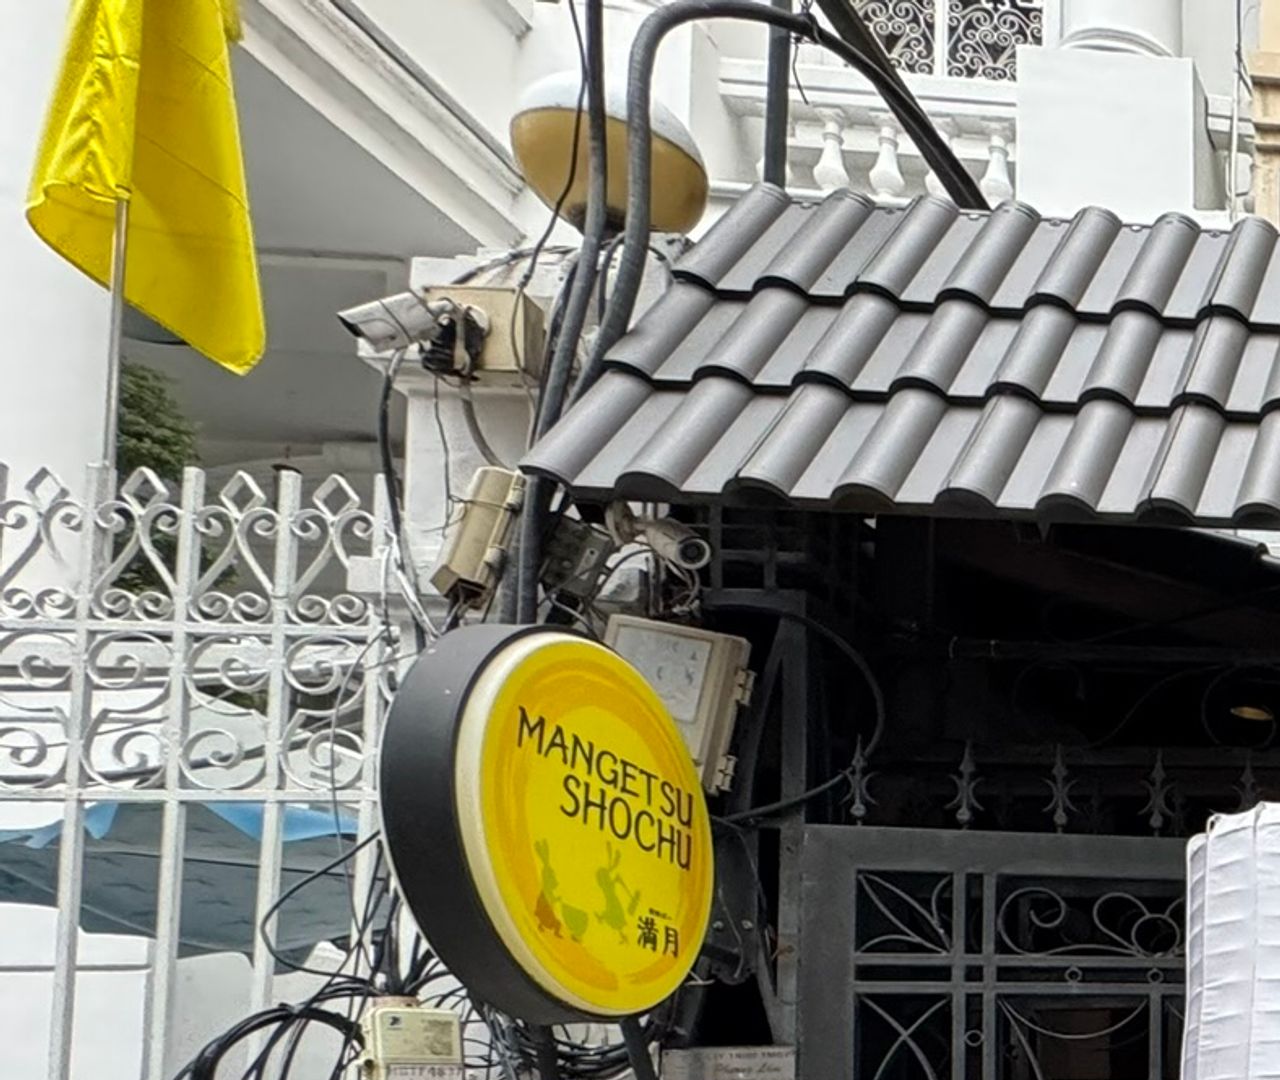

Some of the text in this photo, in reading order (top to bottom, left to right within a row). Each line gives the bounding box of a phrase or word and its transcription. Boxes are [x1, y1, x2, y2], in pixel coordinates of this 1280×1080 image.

[516, 705, 694, 830] MANGETSU
[559, 774, 693, 872] SHOCHU
[636, 915, 679, 959] 満月
